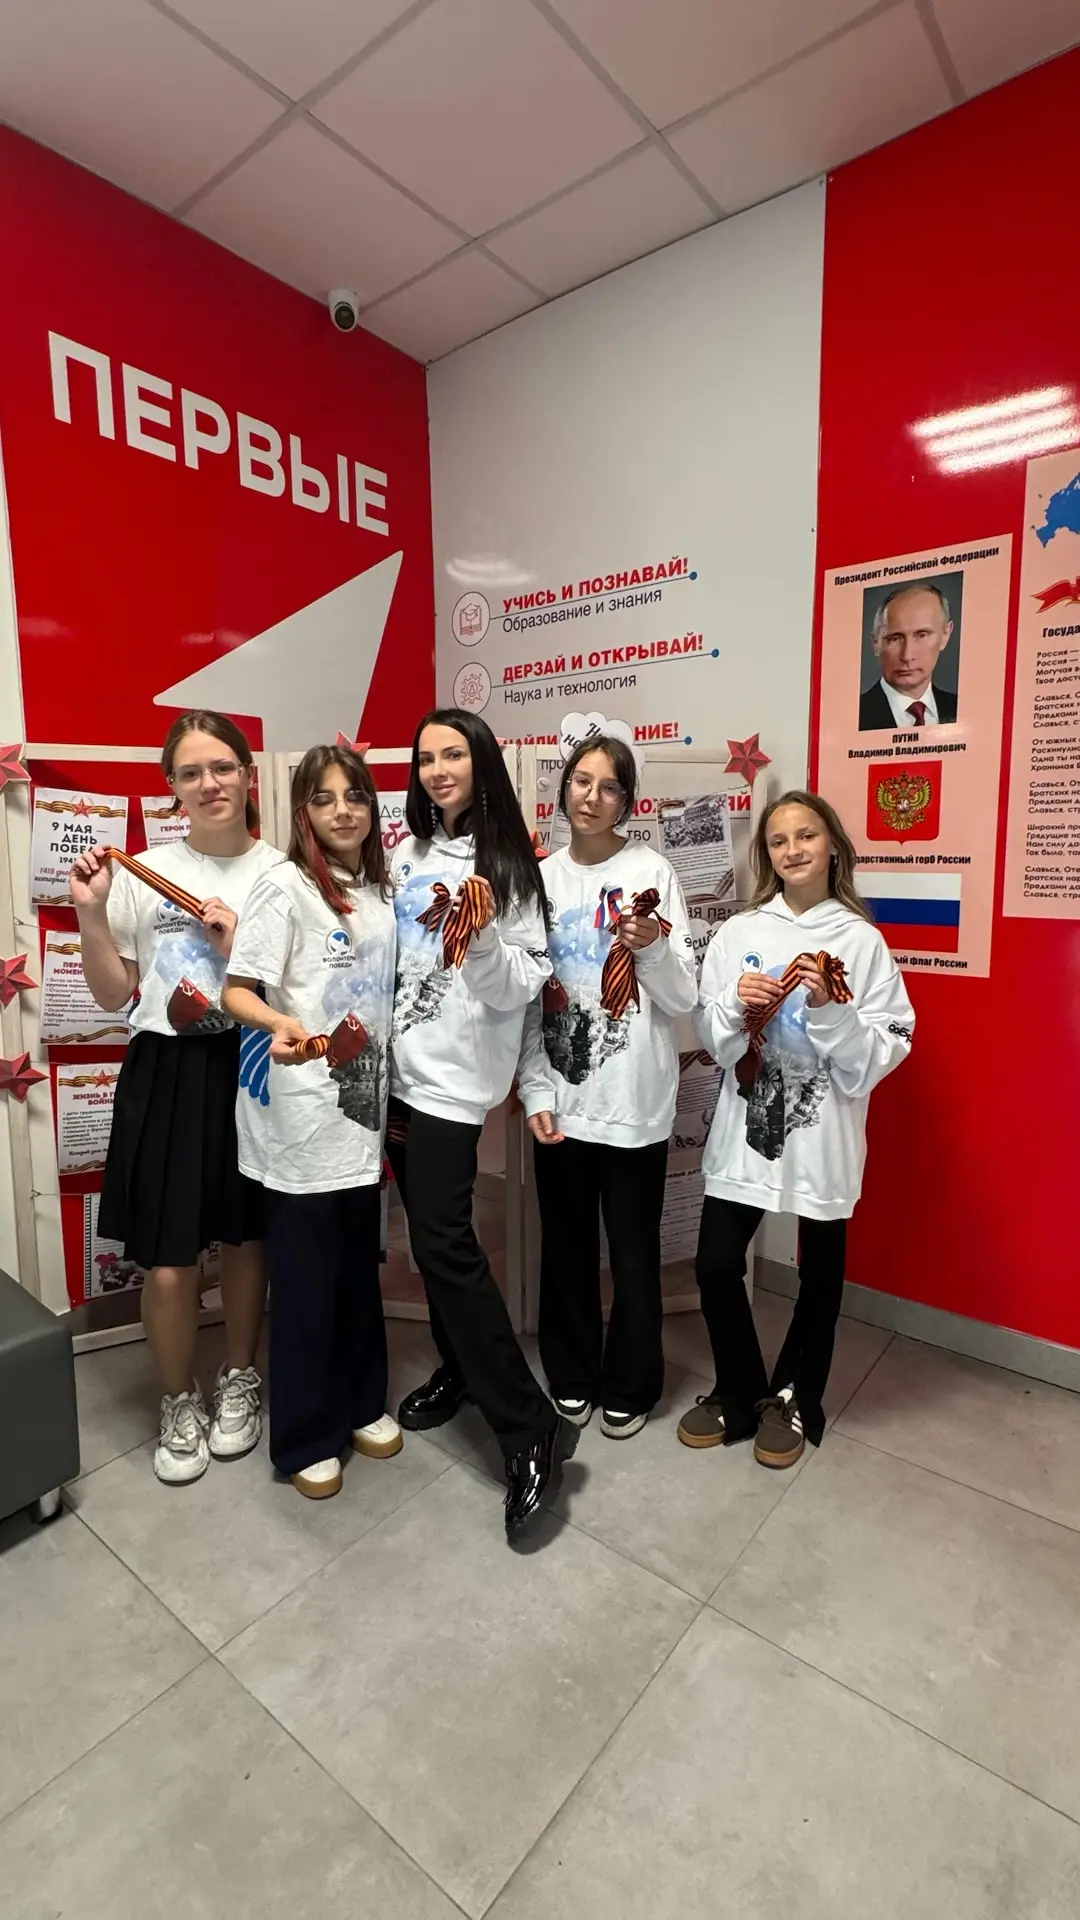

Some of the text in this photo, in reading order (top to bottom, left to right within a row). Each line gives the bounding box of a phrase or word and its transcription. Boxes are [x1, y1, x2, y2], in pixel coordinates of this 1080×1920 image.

[48, 330, 389, 536] ПЕРВЫЕ
[834, 546, 999, 586] Президент Российской Федерации
[503, 555, 689, 613] УЧИСЬ И ПОЗНАВАЙ!
[503, 589, 662, 633] Образование и знания
[503, 632, 703, 684] ДЕРЗАЙ И ОТКРЫВАЙ!
[1036, 650, 1068, 659] Россия
[1036, 659, 1067, 667] Россия
[1035, 667, 1073, 676] Могучая
[504, 675, 637, 706] Наука и технология
[1034, 702, 1075, 712] Братских
[1033, 711, 1078, 720] Предками
[892, 732, 919, 744] ПУТИН
[1032, 737, 1077, 746] От южных
[848, 743, 967, 759] Владимир Владимирович
[1030, 763, 1075, 772] Хранимая
[1029, 789, 1069, 797] Братских
[1028, 798, 1073, 806] Предками
[51, 822, 60, 831] 9
[64, 823, 92, 834] МАЯ
[1027, 823, 1066, 832] Широкий
[61, 834, 98, 845] ДЕНЬ
[1026, 832, 1069, 840] Грядущие
[50, 842, 94, 854] ПОБЕ
[1046, 841, 1066, 849] силу
[915, 855, 935, 865] герб
[937, 855, 971, 865] России
[1024, 882, 1067, 890] Предками
[158, 927, 185, 935] ПОБЕДЫ
[909, 956, 932, 966] флаг
[934, 957, 968, 969] России
